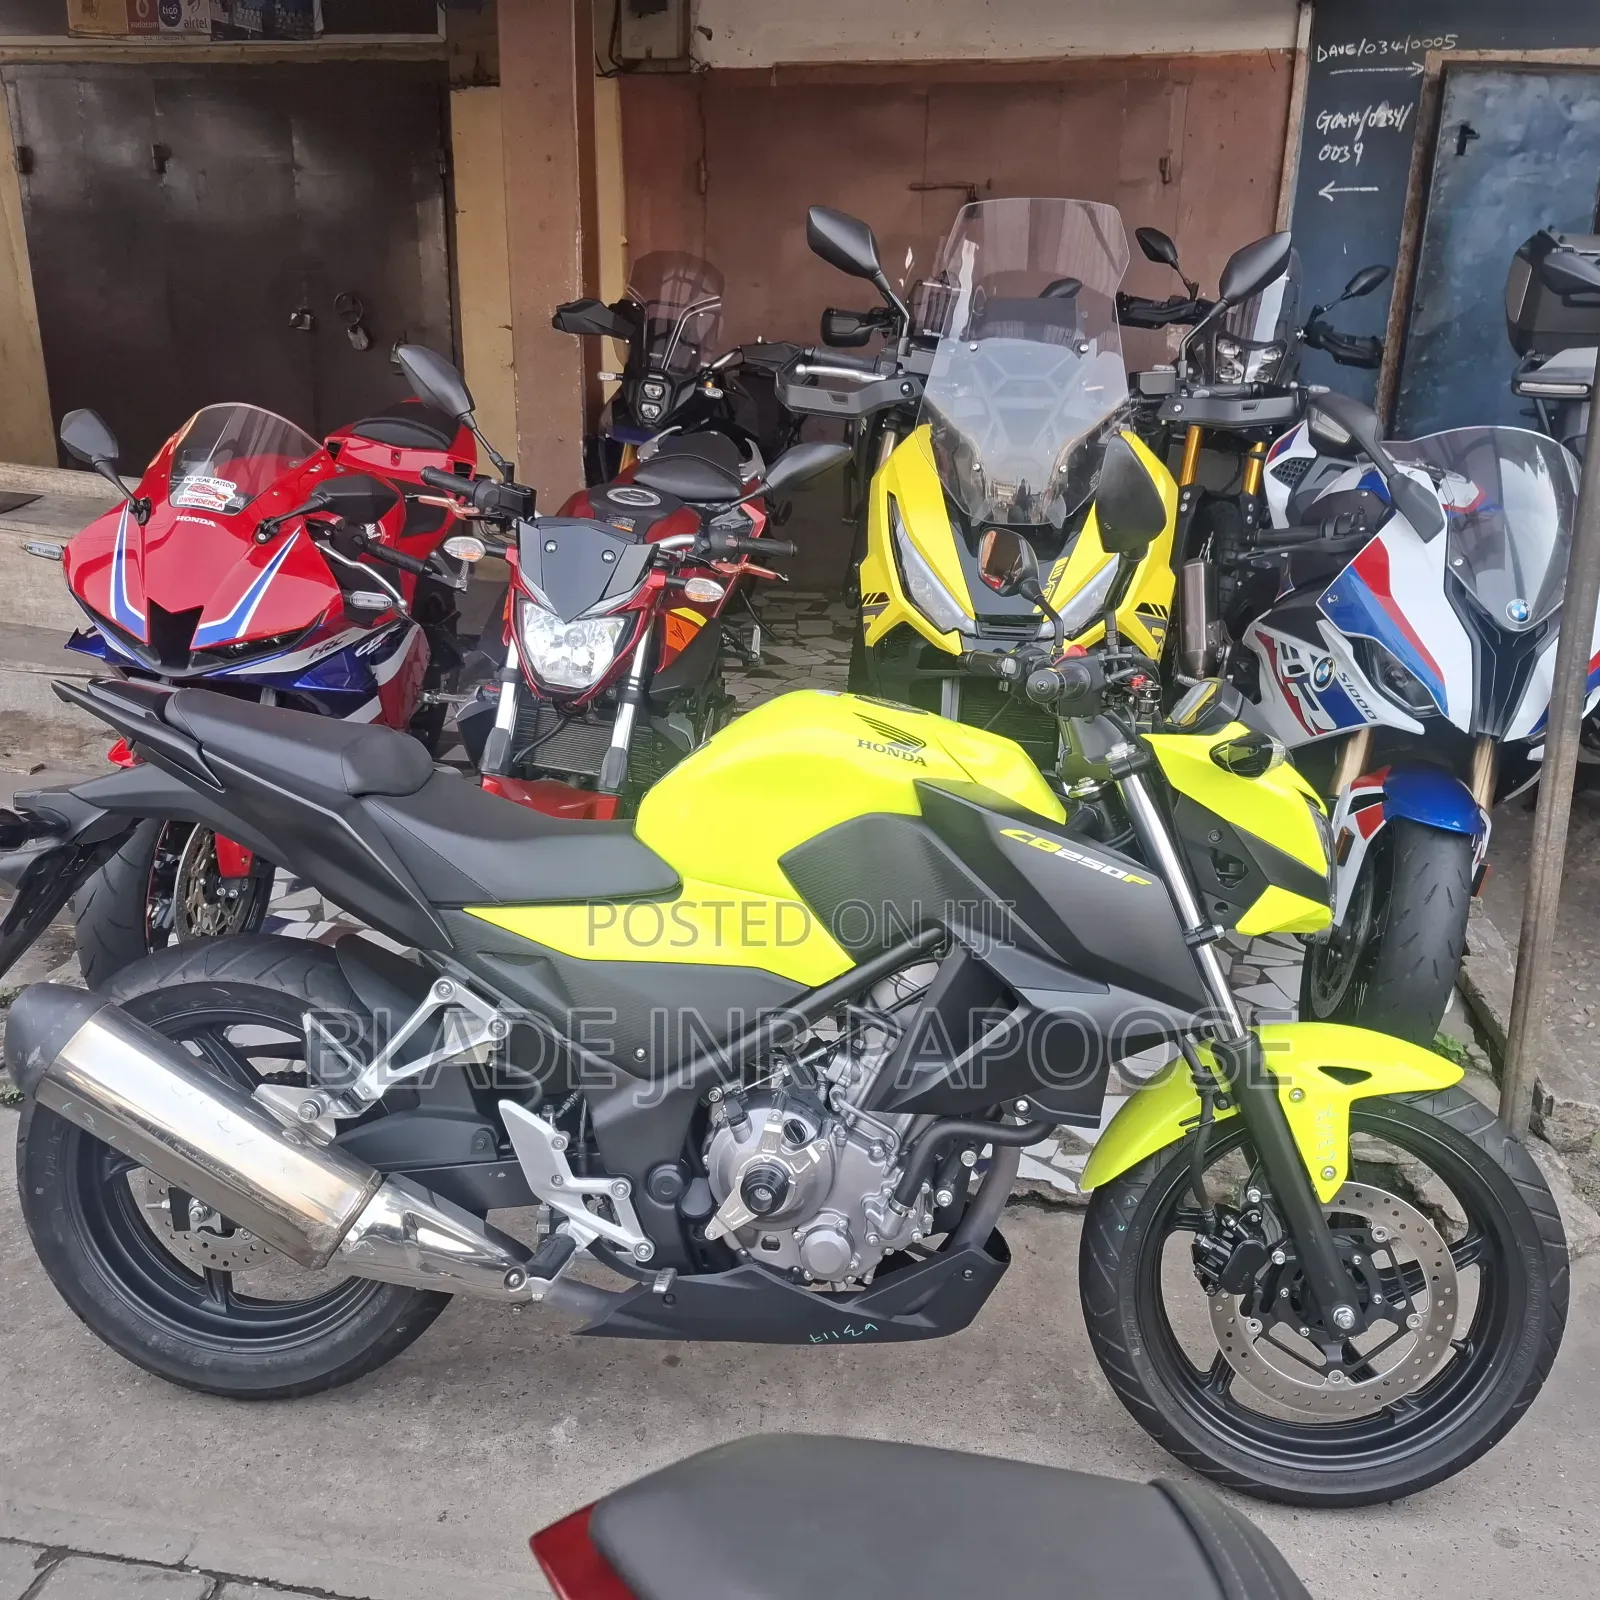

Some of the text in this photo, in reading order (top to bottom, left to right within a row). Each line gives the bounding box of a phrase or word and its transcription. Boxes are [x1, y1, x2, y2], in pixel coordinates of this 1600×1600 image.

[130, 20, 158, 28] vodacom
[184, 16, 208, 28] airtel
[176, 515, 216, 527] HONDA
[1338, 672, 1378, 720] S1000
[857, 738, 928, 768] HONDA
[999, 828, 1153, 887] CB250F
